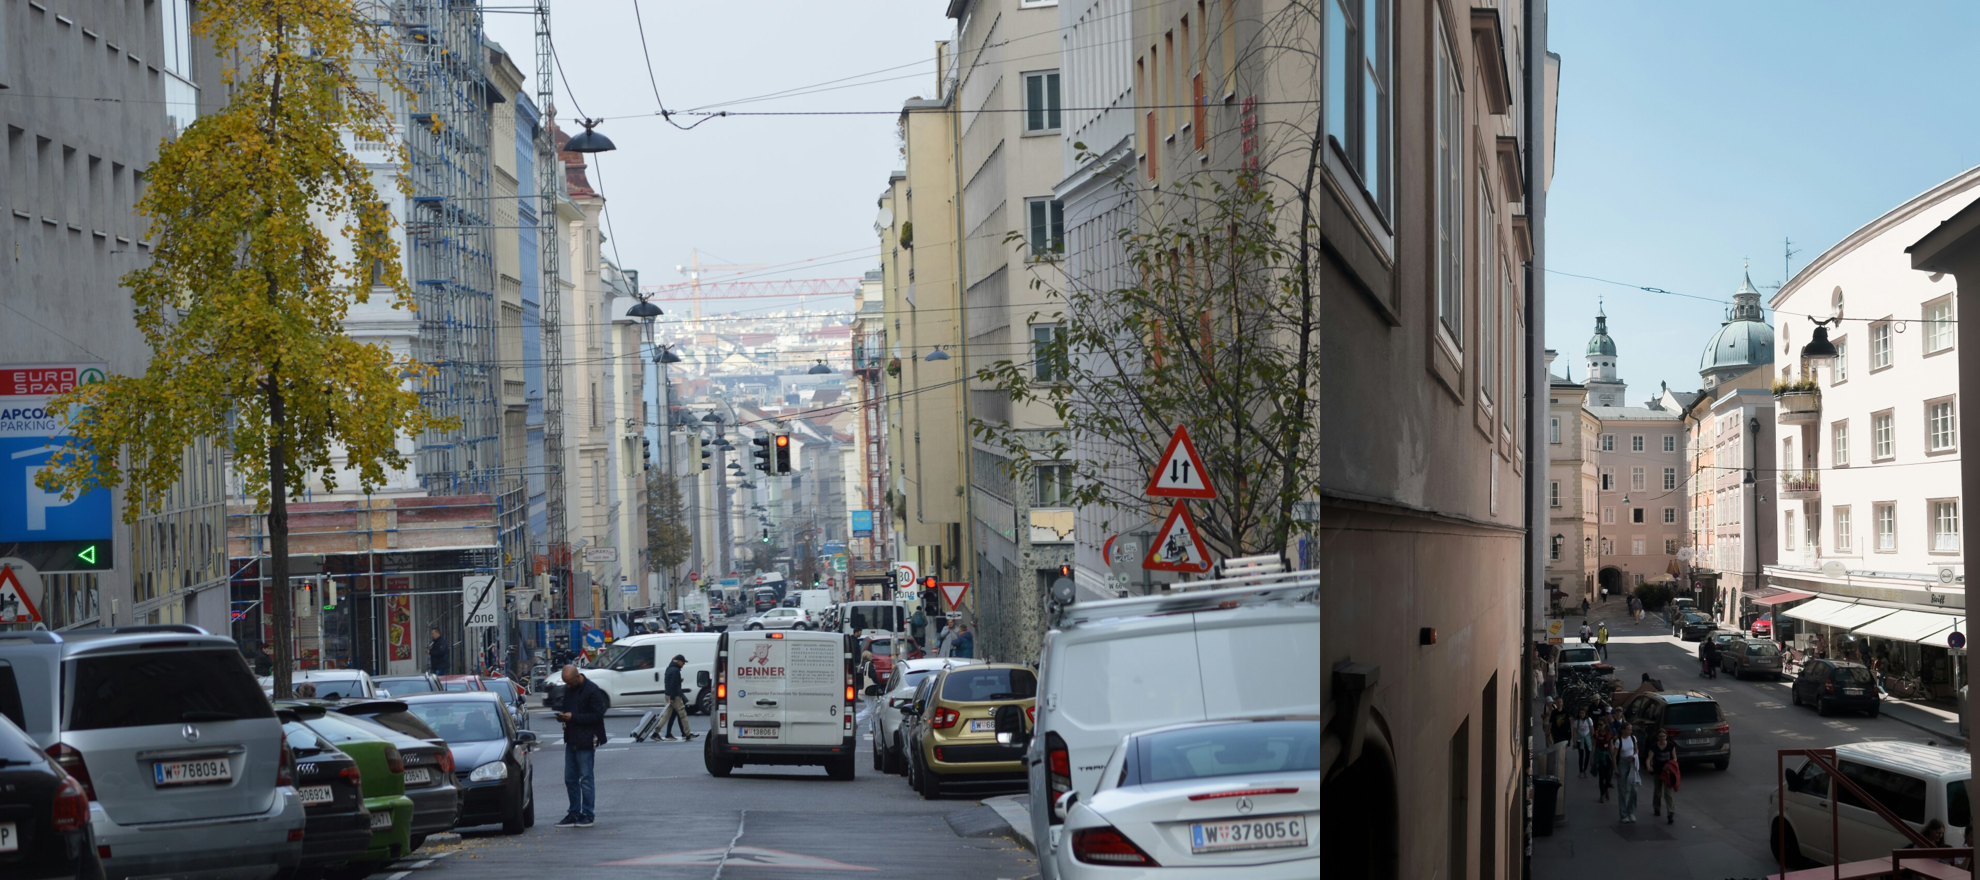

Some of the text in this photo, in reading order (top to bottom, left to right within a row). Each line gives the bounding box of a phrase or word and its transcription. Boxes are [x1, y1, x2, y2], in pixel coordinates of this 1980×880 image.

[13, 371, 74, 382] EURO
[14, 383, 74, 394] SPAR
[0, 420, 55, 431] PARKING
[470, 586, 490, 604] 30
[737, 667, 785, 676] DENNER
[830, 705, 837, 716] 6
[1205, 826, 1218, 843] W
